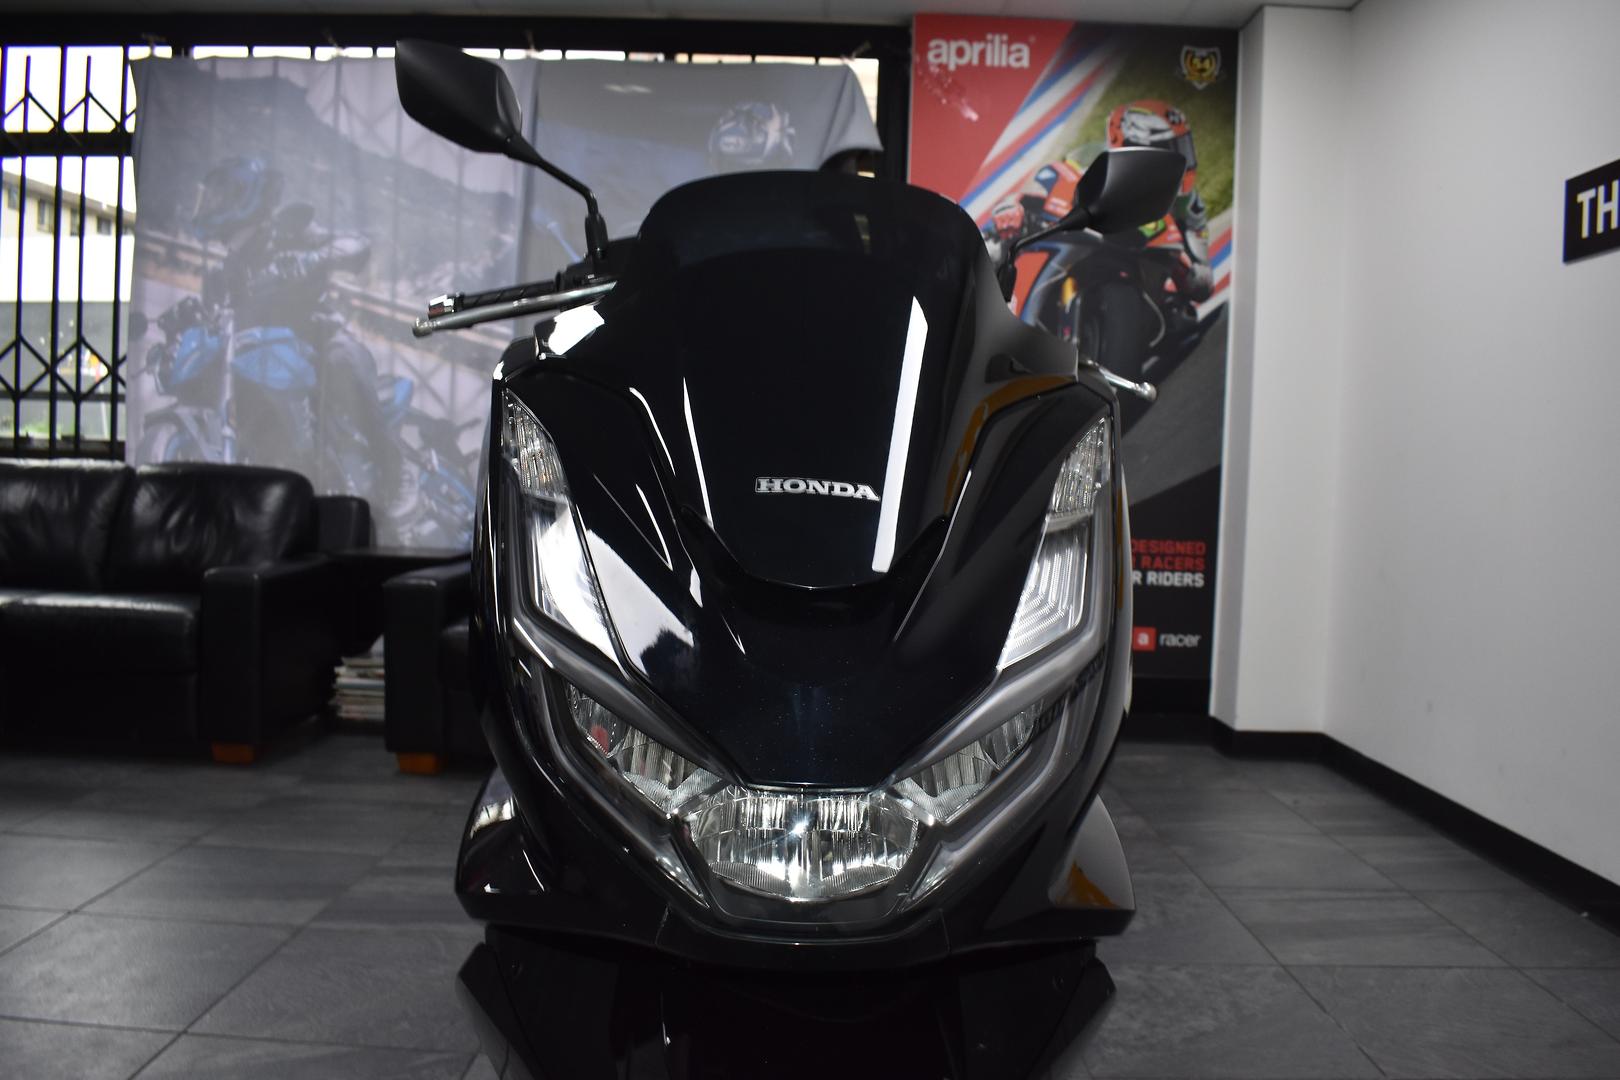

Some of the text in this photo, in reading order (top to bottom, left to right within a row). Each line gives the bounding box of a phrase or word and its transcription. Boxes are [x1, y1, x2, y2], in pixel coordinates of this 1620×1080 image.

[927, 33, 1031, 71] aprilia
[755, 477, 880, 502] HONDA
[1142, 556, 1204, 570] RACERS
[1147, 571, 1204, 587] RIDERS
[1159, 634, 1201, 647] racer
